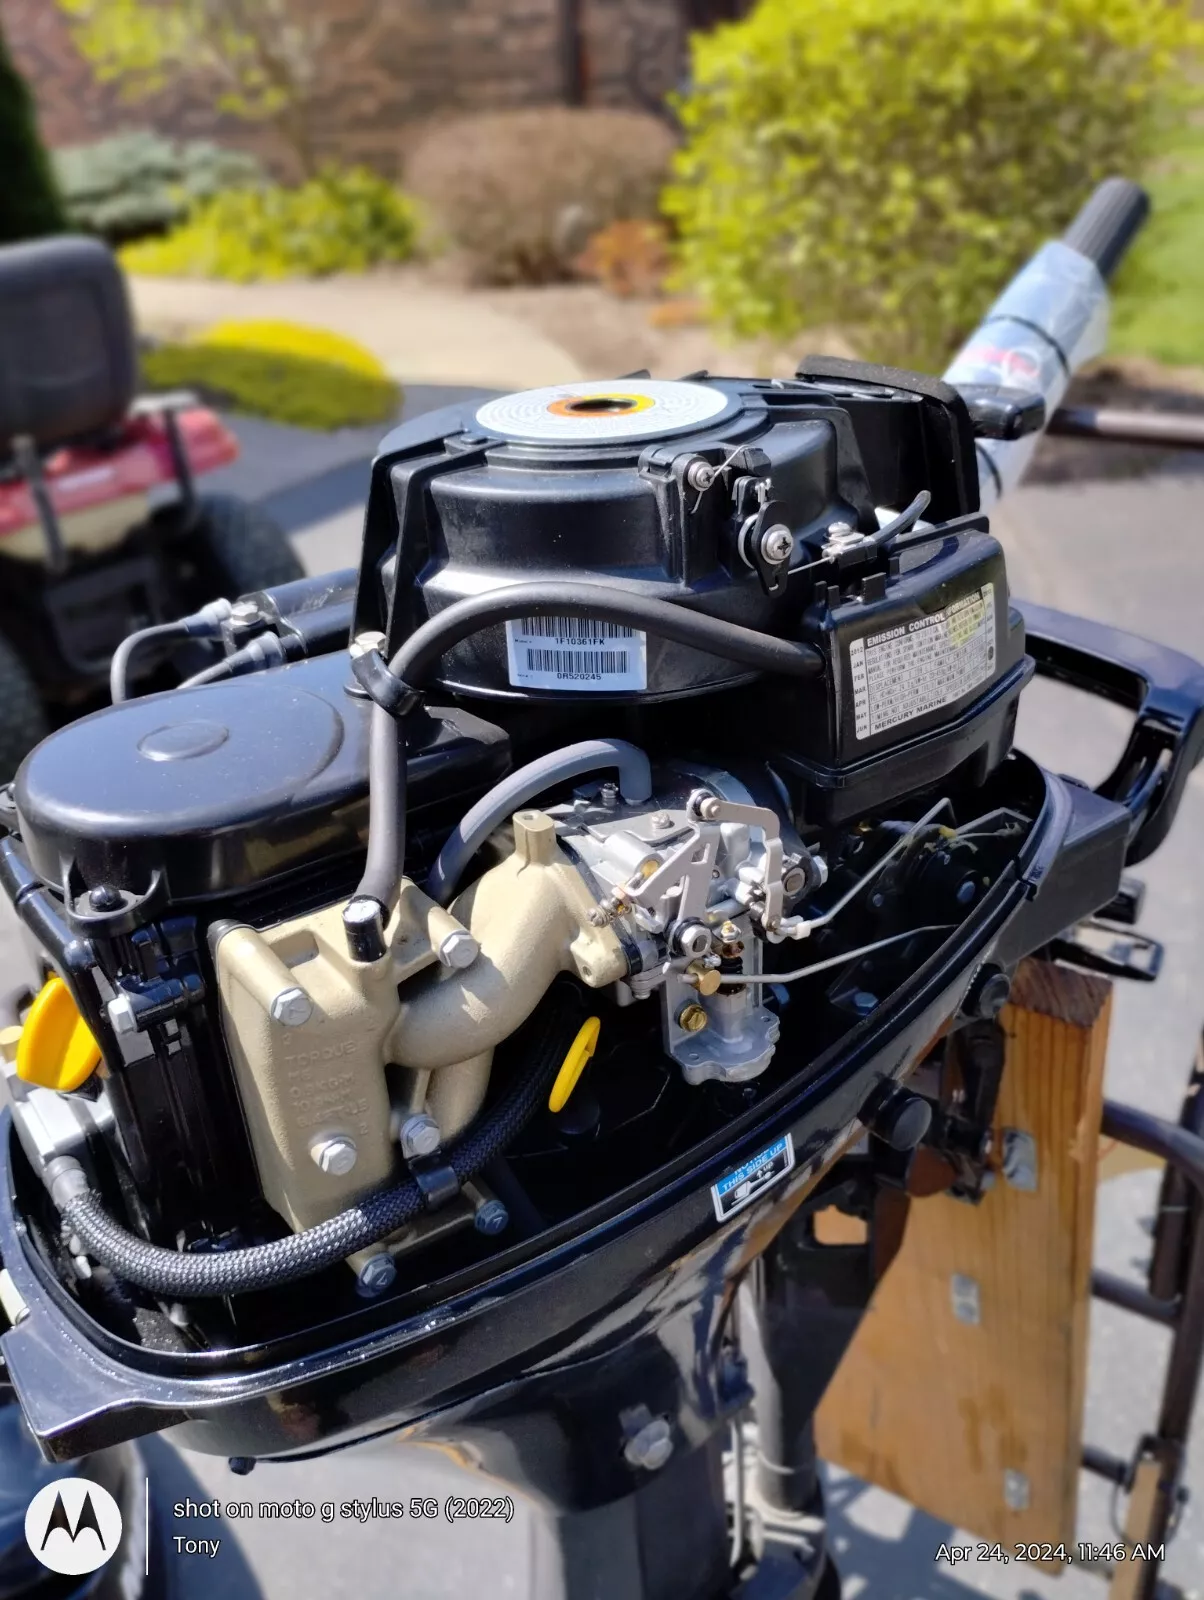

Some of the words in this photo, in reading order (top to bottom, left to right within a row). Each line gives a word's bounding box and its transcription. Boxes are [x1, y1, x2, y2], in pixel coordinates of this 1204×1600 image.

[867, 627, 906, 646] EMISSION
[908, 614, 946, 632] CONTROL
[554, 638, 605, 646] 1F10361FK
[853, 660, 864, 668] JAN
[854, 673, 864, 682] FEB
[854, 686, 866, 694] MAR
[856, 699, 866, 708] APR
[856, 712, 867, 720] MAY
[874, 710, 914, 730] MERCURY
[916, 696, 947, 714] MARINE
[284, 1040, 357, 1065] TORQUE
[722, 1172, 744, 1190] THIS
[746, 1154, 768, 1174] SIDE
[770, 1143, 782, 1156] UP
